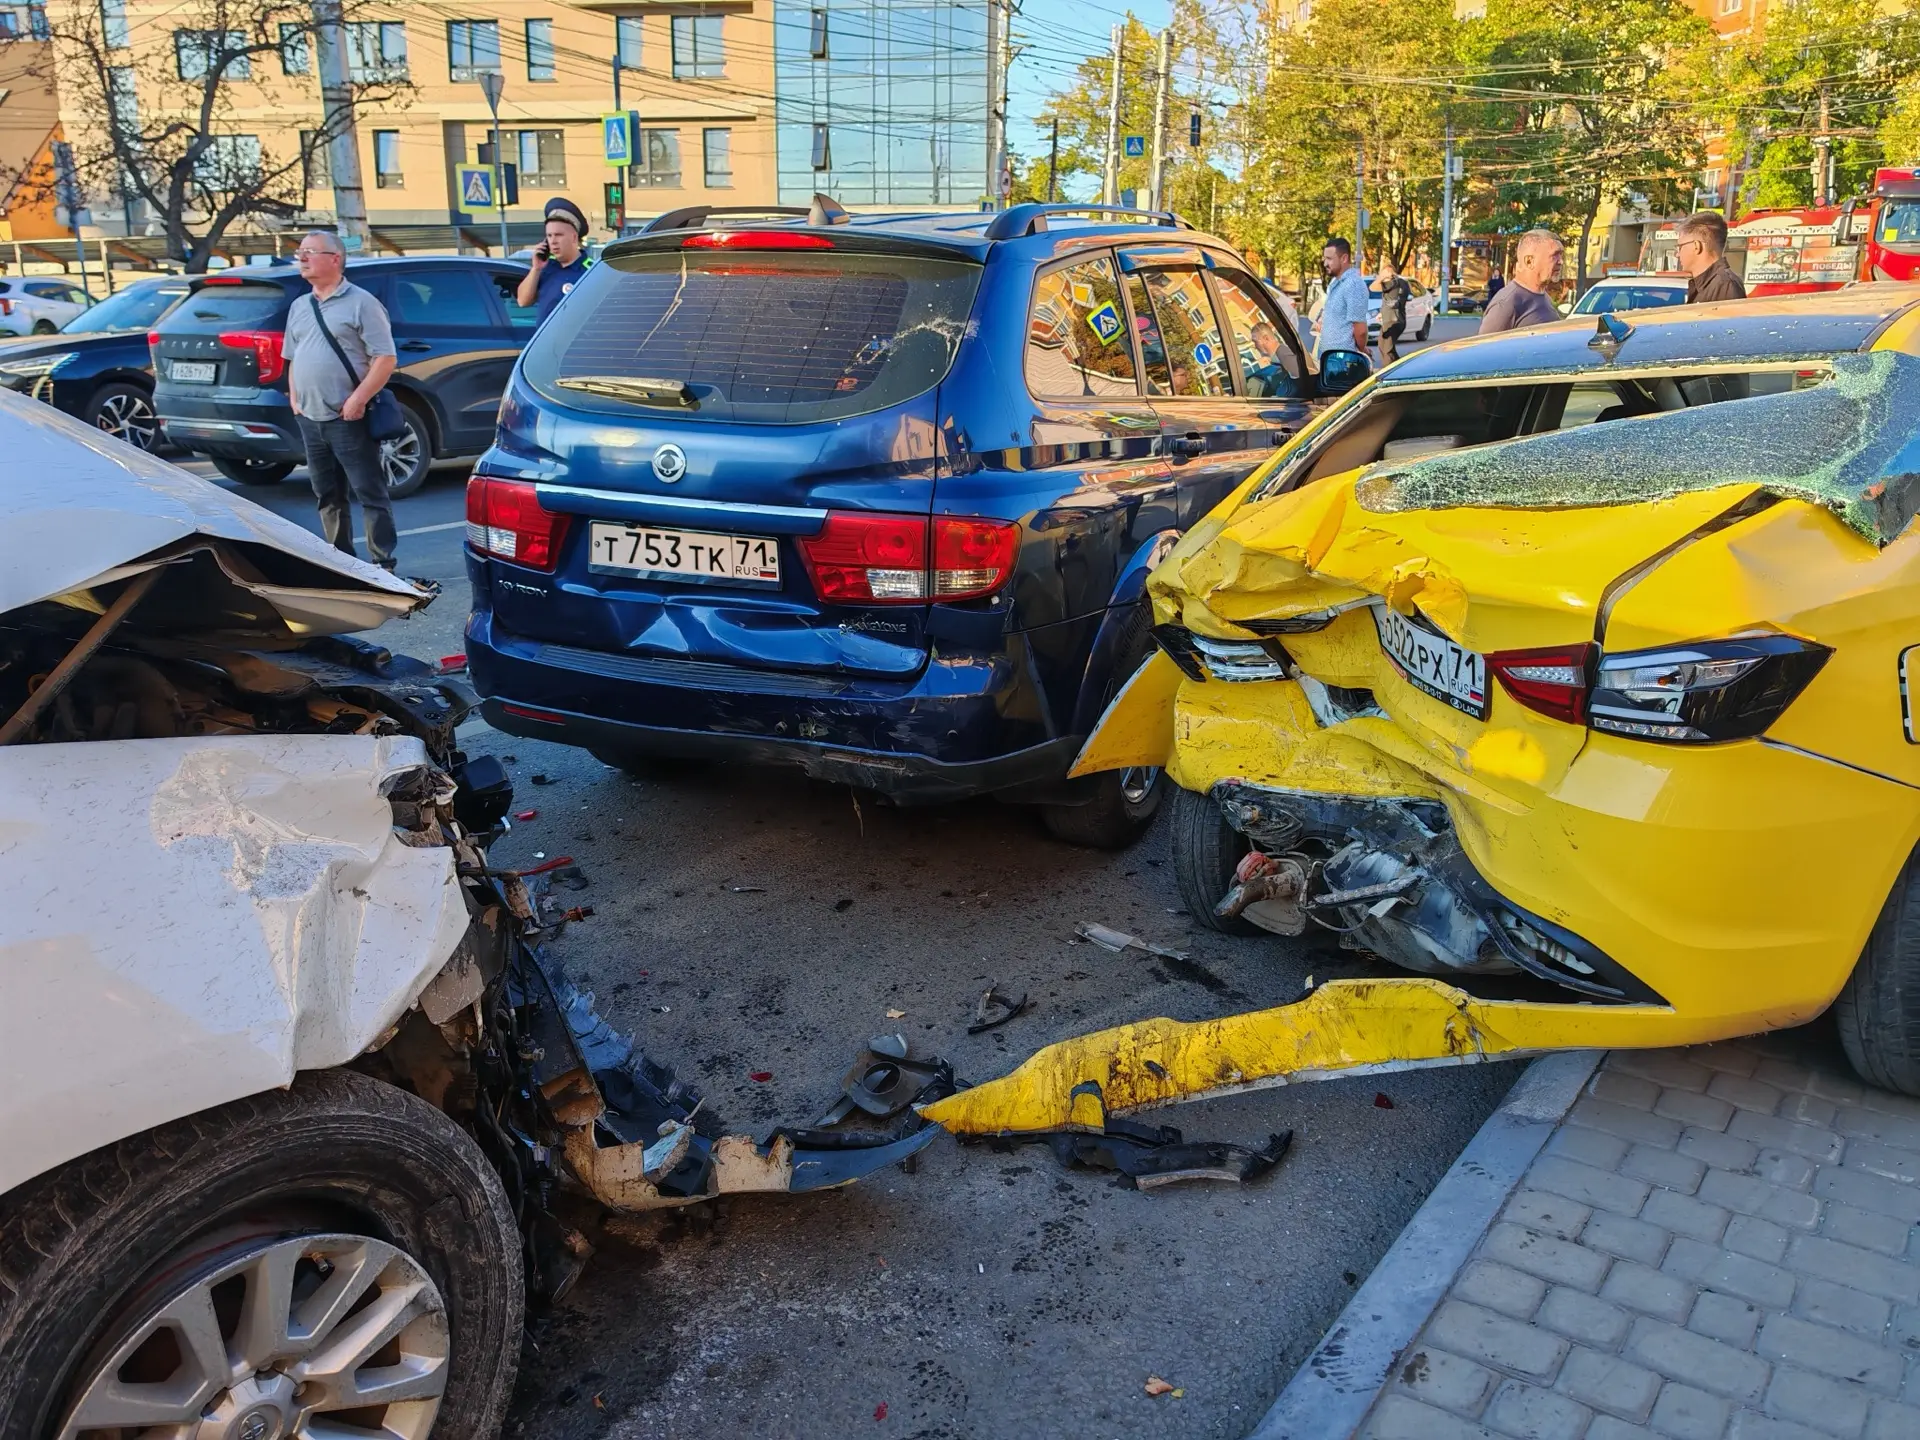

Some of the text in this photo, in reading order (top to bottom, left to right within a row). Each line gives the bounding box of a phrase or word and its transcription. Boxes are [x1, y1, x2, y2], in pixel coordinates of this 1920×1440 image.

[1812, 262, 1852, 270] ПОБЕДЫ
[736, 540, 768, 566] 71
[735, 566, 760, 577] RUS
[1451, 646, 1476, 686] 71
[1451, 678, 1470, 696] RUS
[1462, 702, 1480, 718] LADA
